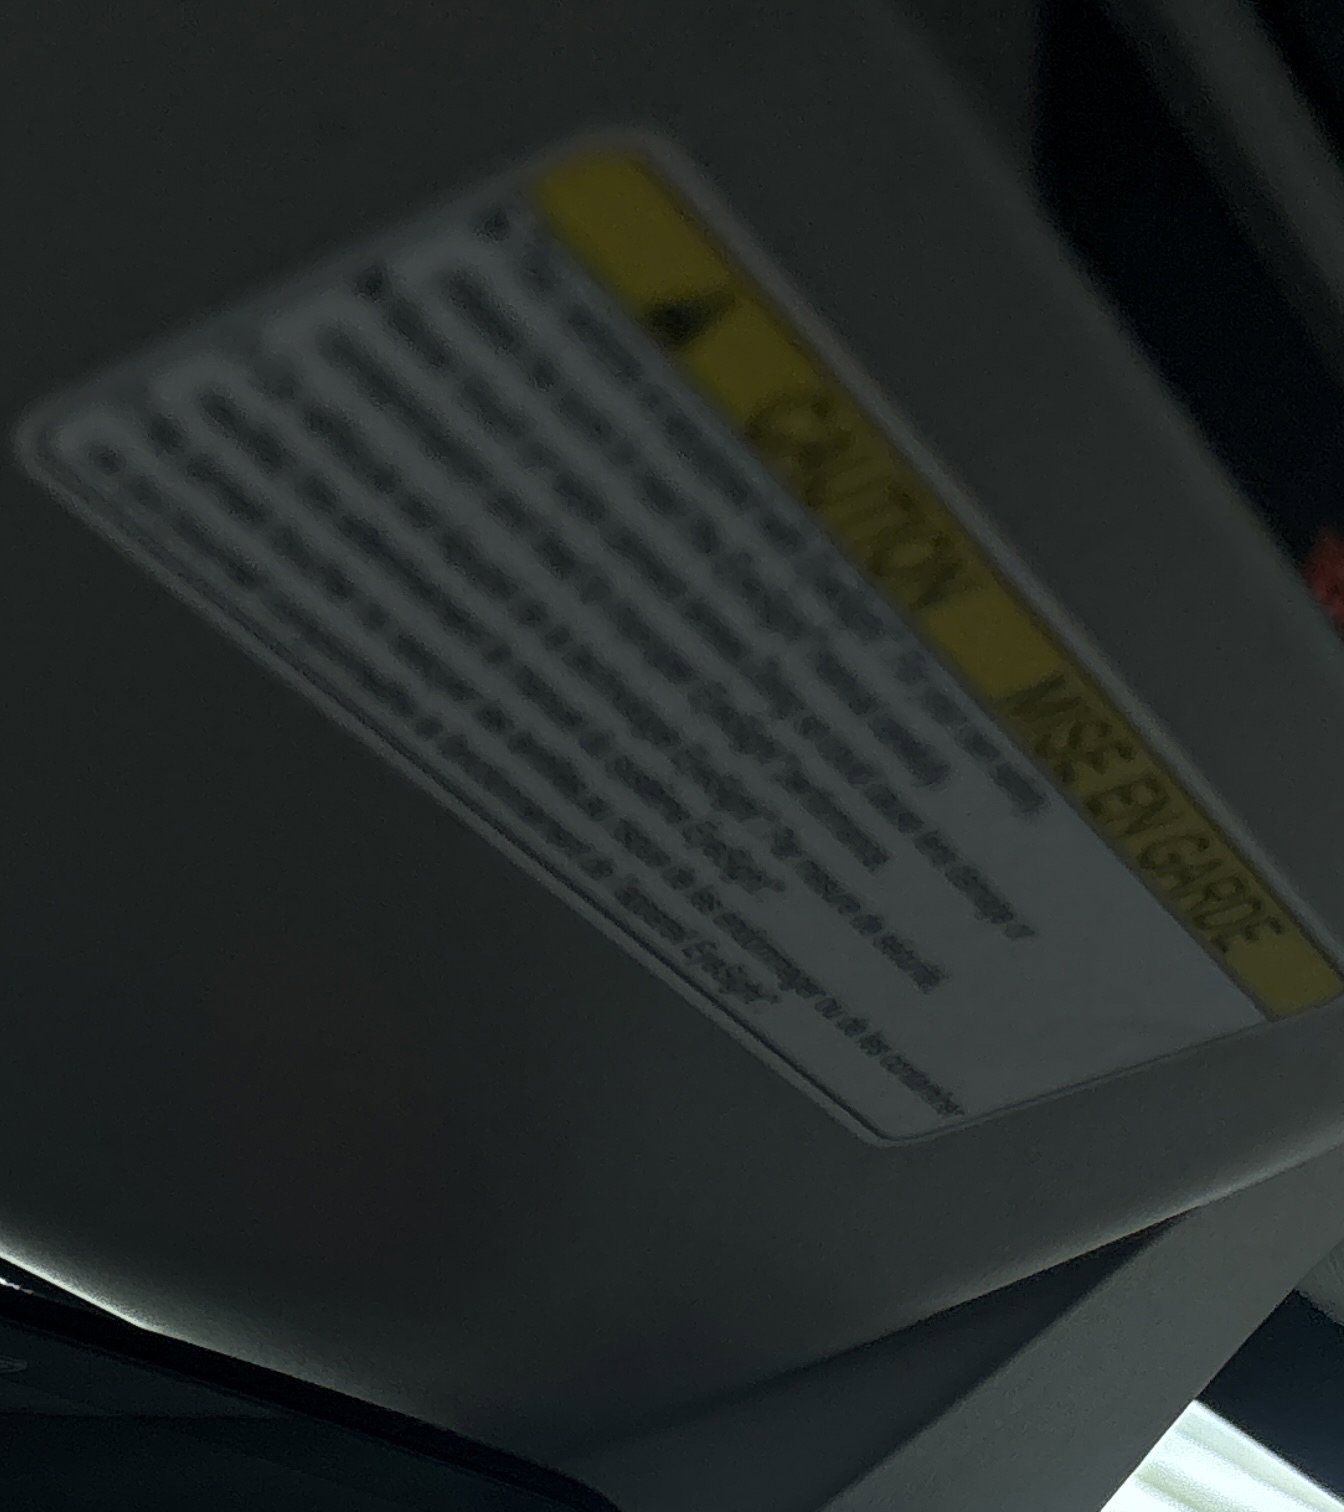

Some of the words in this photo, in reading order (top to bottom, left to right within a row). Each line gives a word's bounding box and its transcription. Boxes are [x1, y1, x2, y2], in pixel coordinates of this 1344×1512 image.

[743, 387, 984, 608] CAUTION
[1000, 672, 1134, 781] MISE
[1084, 770, 1180, 836] EN
[1137, 835, 1283, 953] GARDE
